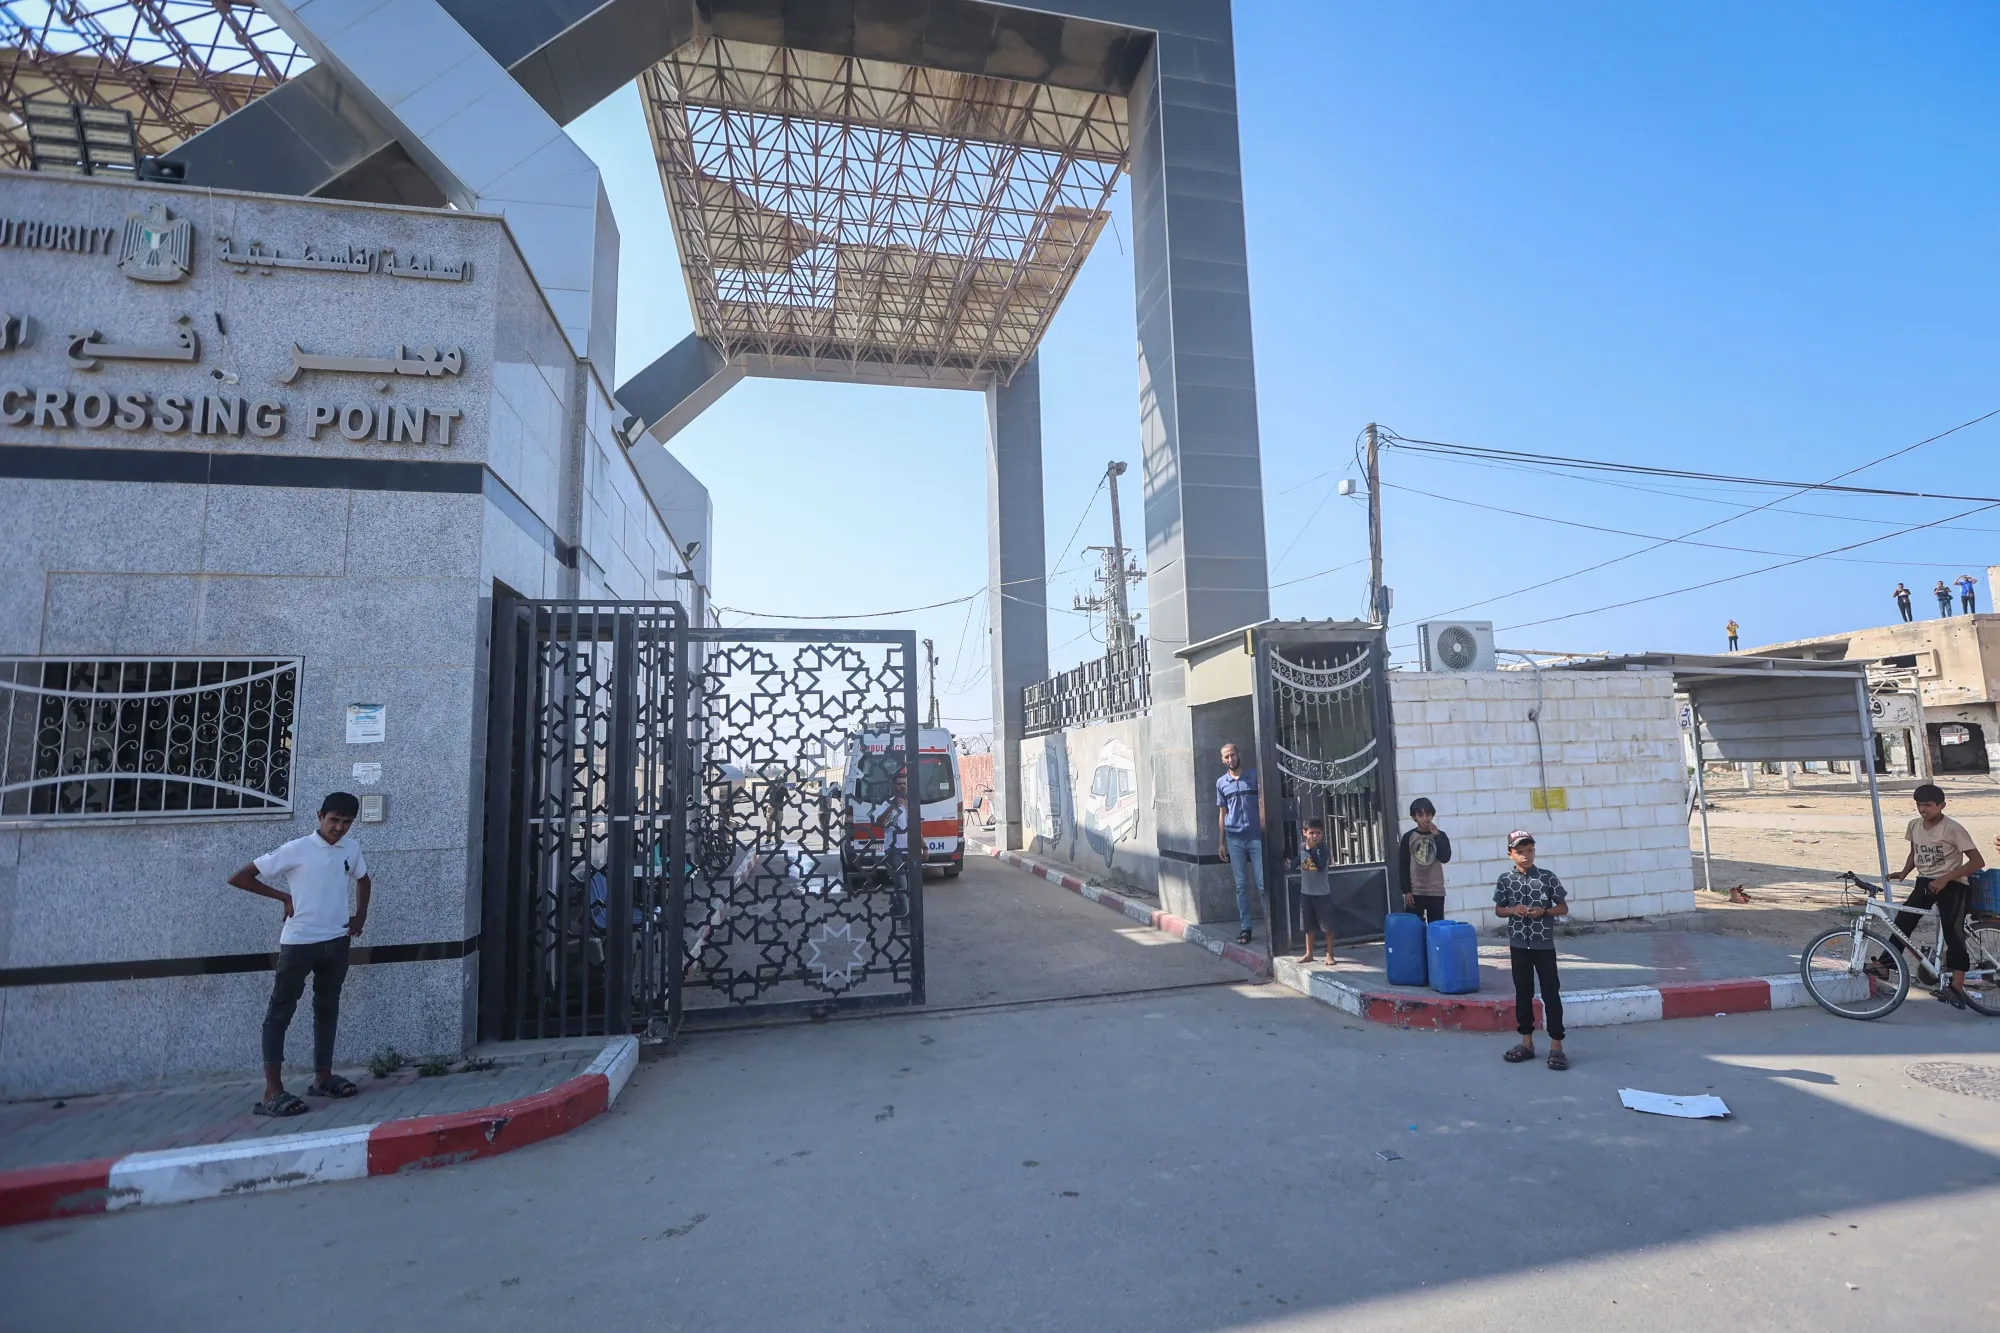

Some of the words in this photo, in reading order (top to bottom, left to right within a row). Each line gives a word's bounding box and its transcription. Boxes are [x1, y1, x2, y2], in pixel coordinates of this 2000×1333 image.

[277, 341, 462, 393] معبر
[0, 382, 283, 438] CROSSING
[306, 401, 460, 445] POINT
